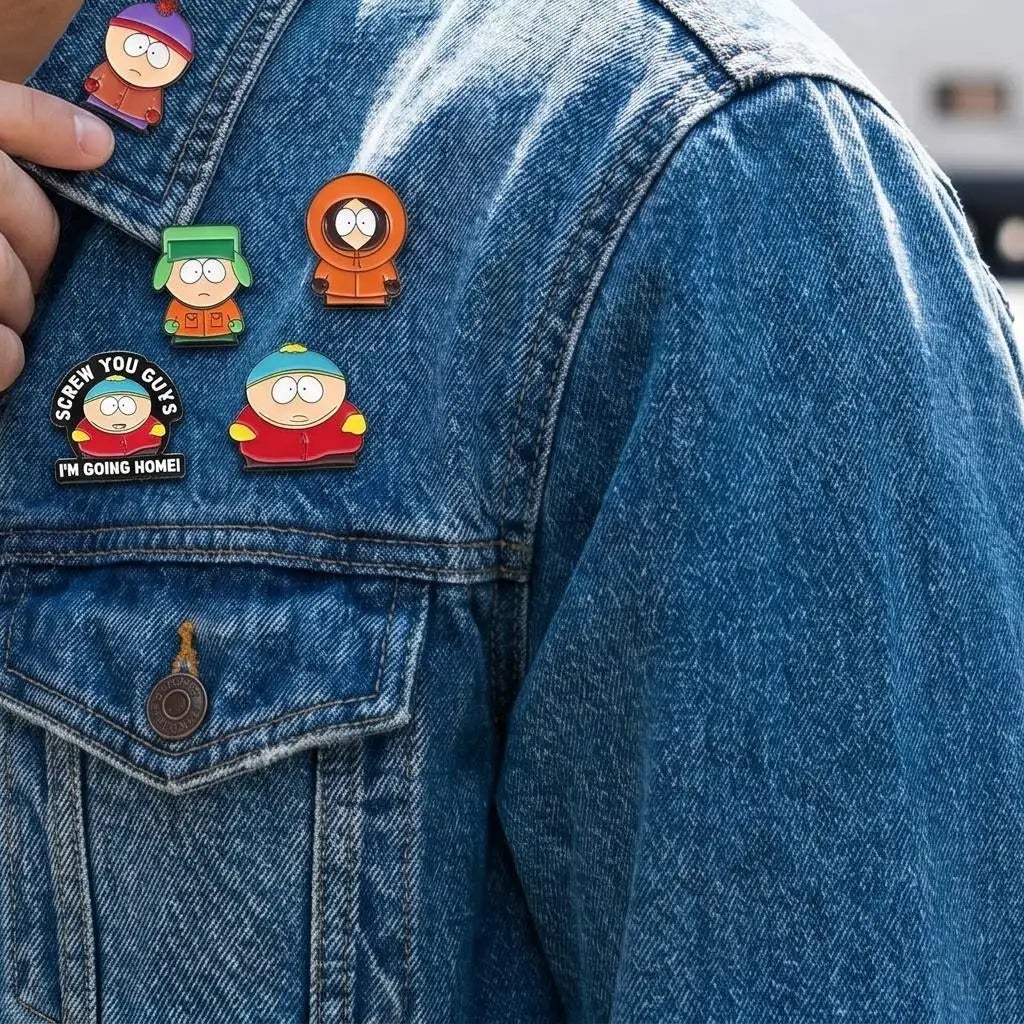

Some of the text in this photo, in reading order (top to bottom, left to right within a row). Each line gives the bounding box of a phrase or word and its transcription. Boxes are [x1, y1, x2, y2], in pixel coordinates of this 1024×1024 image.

[56, 356, 177, 421] SCREW YOU GUYS
[59, 463, 79, 477] I'M
[83, 461, 131, 476] GOING
